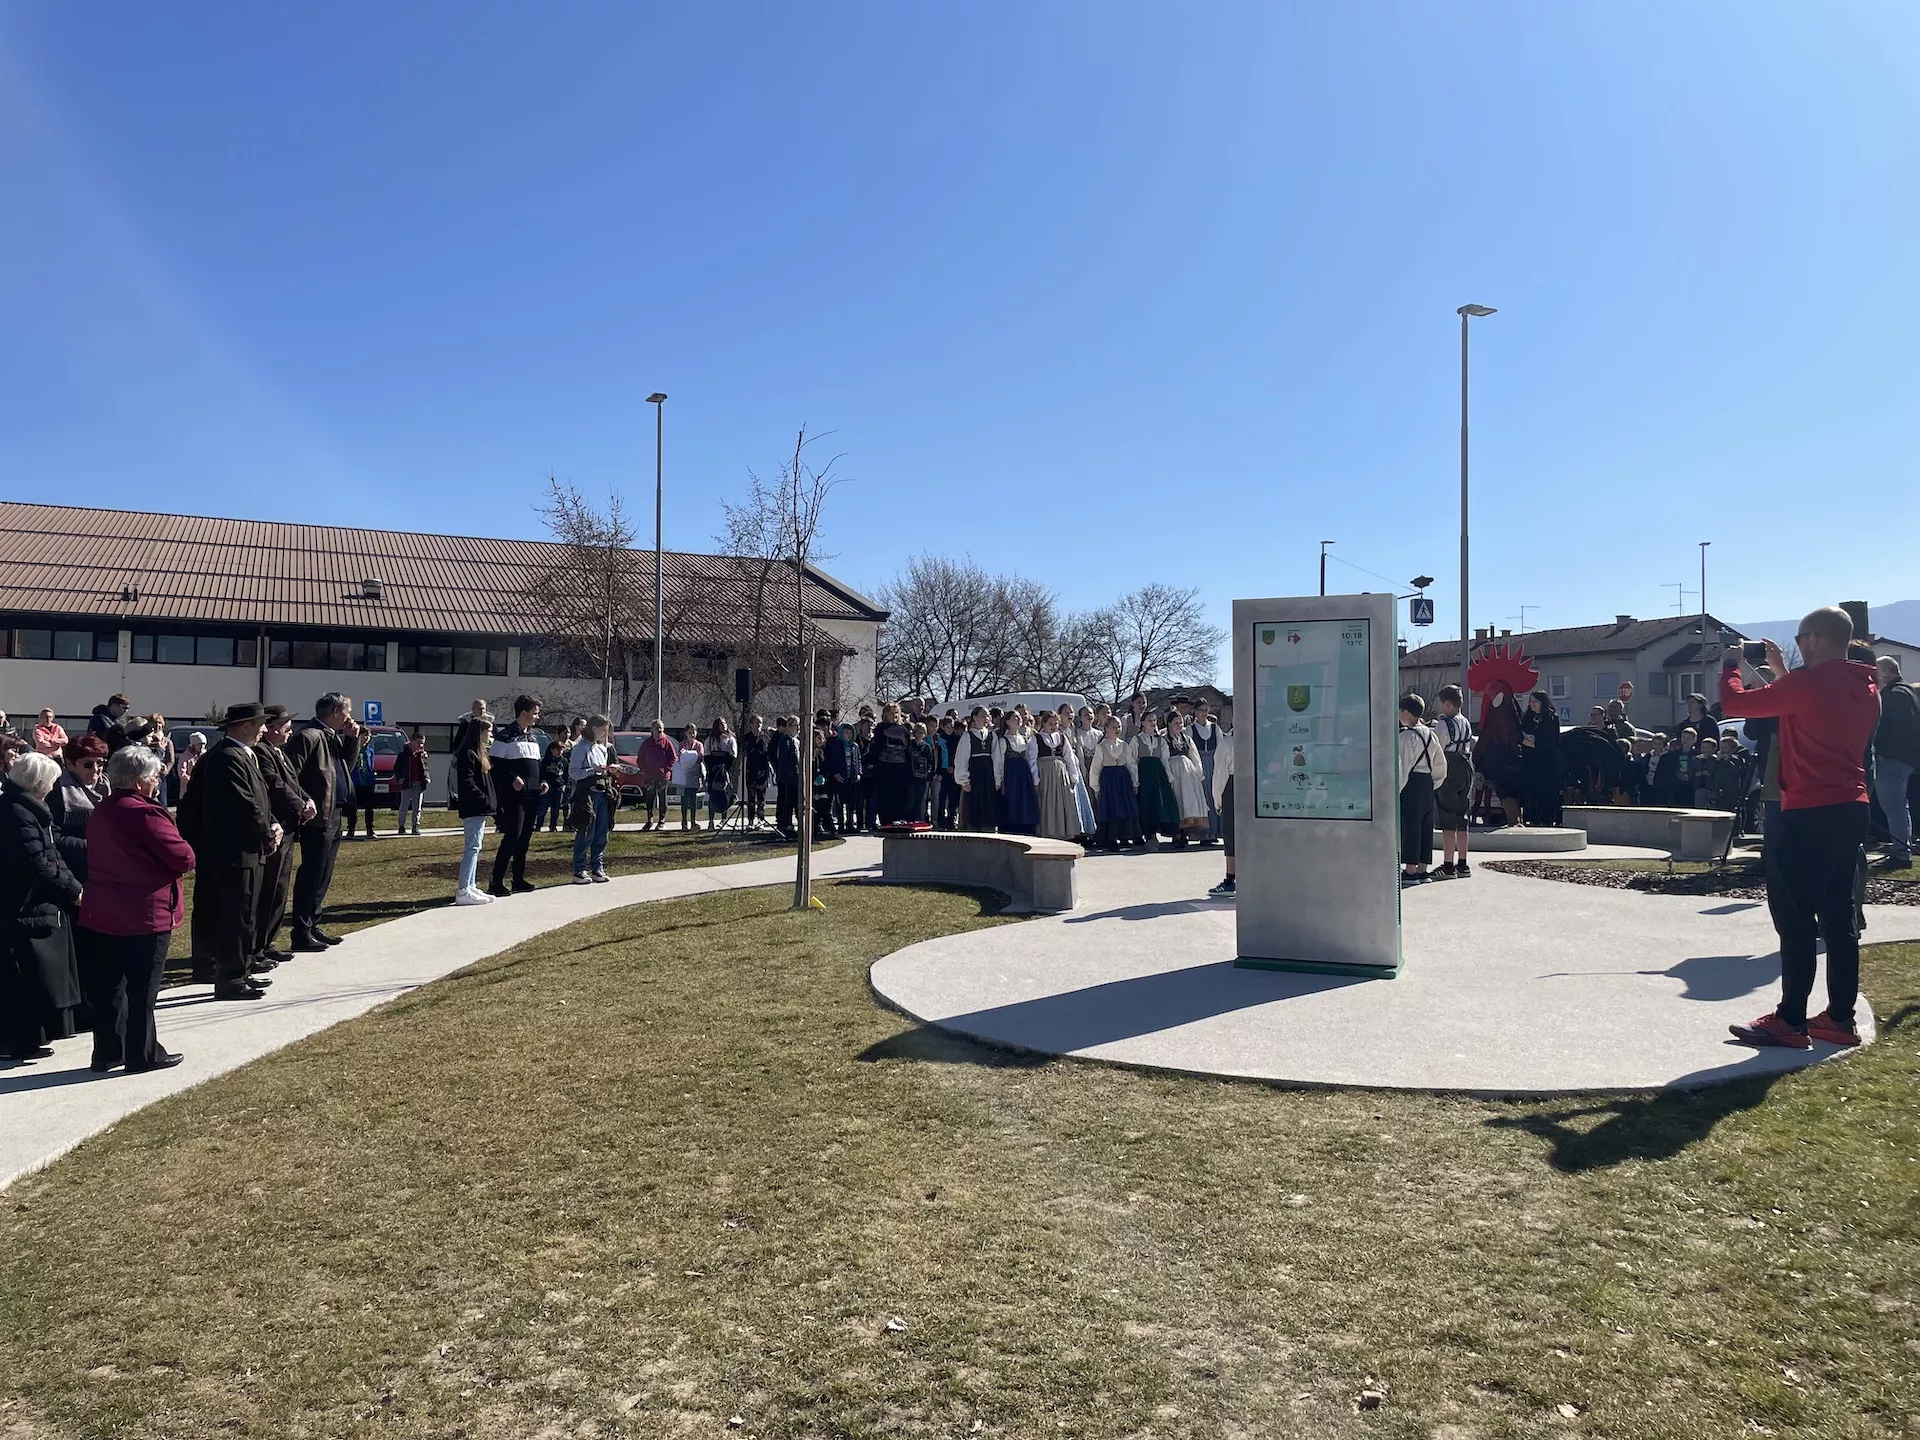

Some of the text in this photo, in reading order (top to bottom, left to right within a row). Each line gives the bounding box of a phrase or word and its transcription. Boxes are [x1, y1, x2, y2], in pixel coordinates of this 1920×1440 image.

[1619, 688, 1632, 697] STOP
[368, 703, 378, 720] P
[1680, 761, 1688, 772] 3
